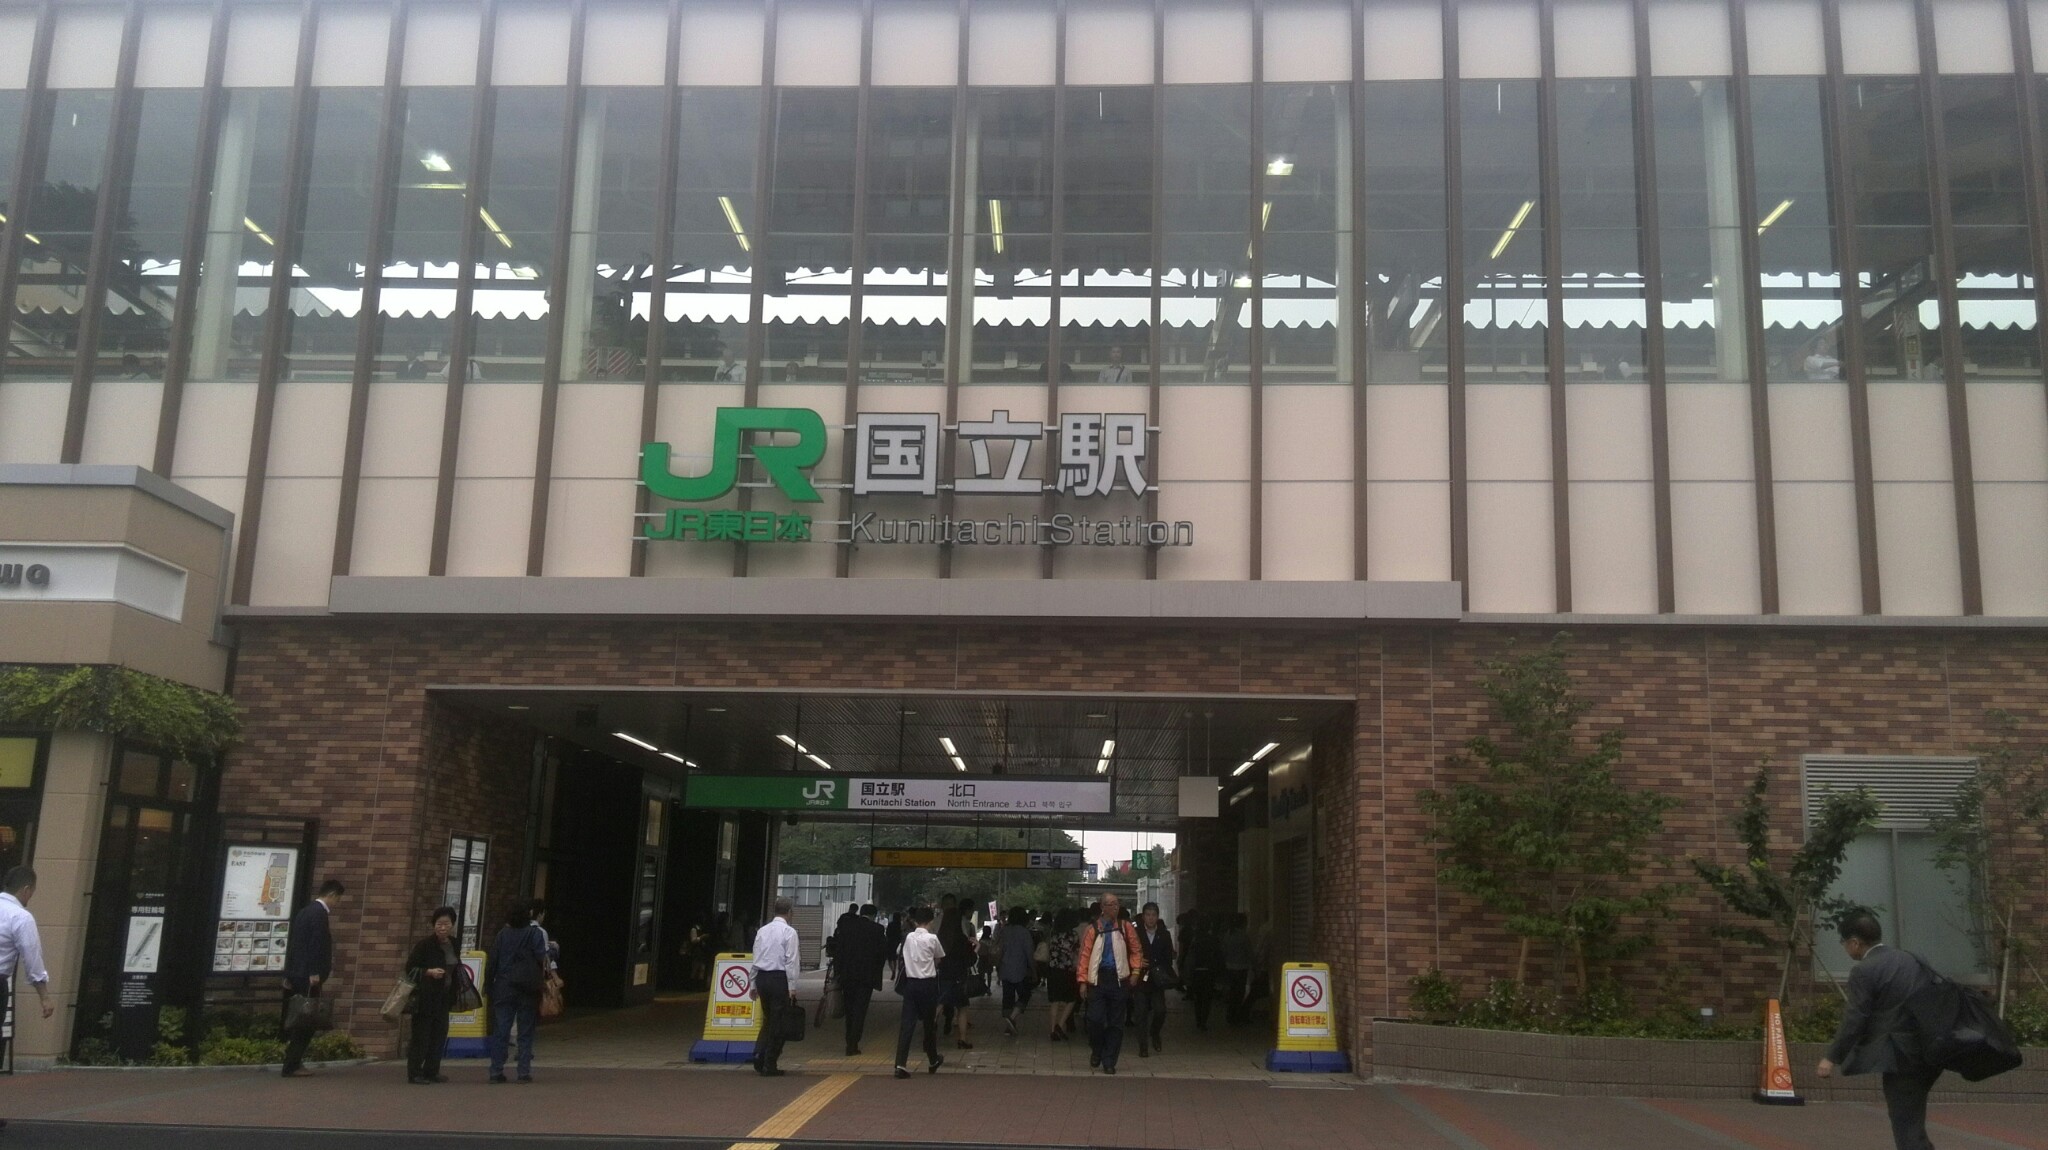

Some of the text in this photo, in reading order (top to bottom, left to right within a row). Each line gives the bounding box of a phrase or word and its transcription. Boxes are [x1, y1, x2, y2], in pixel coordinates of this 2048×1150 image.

[642, 406, 828, 503] JR
[853, 410, 1149, 501] 国立駅
[643, 508, 814, 543] JR東日本
[850, 511, 1194, 547] Kunitachi Station
[802, 780, 836, 800] JR
[860, 797, 936, 808] Kunitachi Station
[861, 782, 976, 797] 国立駅 北口
[947, 799, 1010, 809] North Entrance
[1015, 800, 1037, 809] 北入口
[1774, 1013, 1784, 1067] NO PARKING
